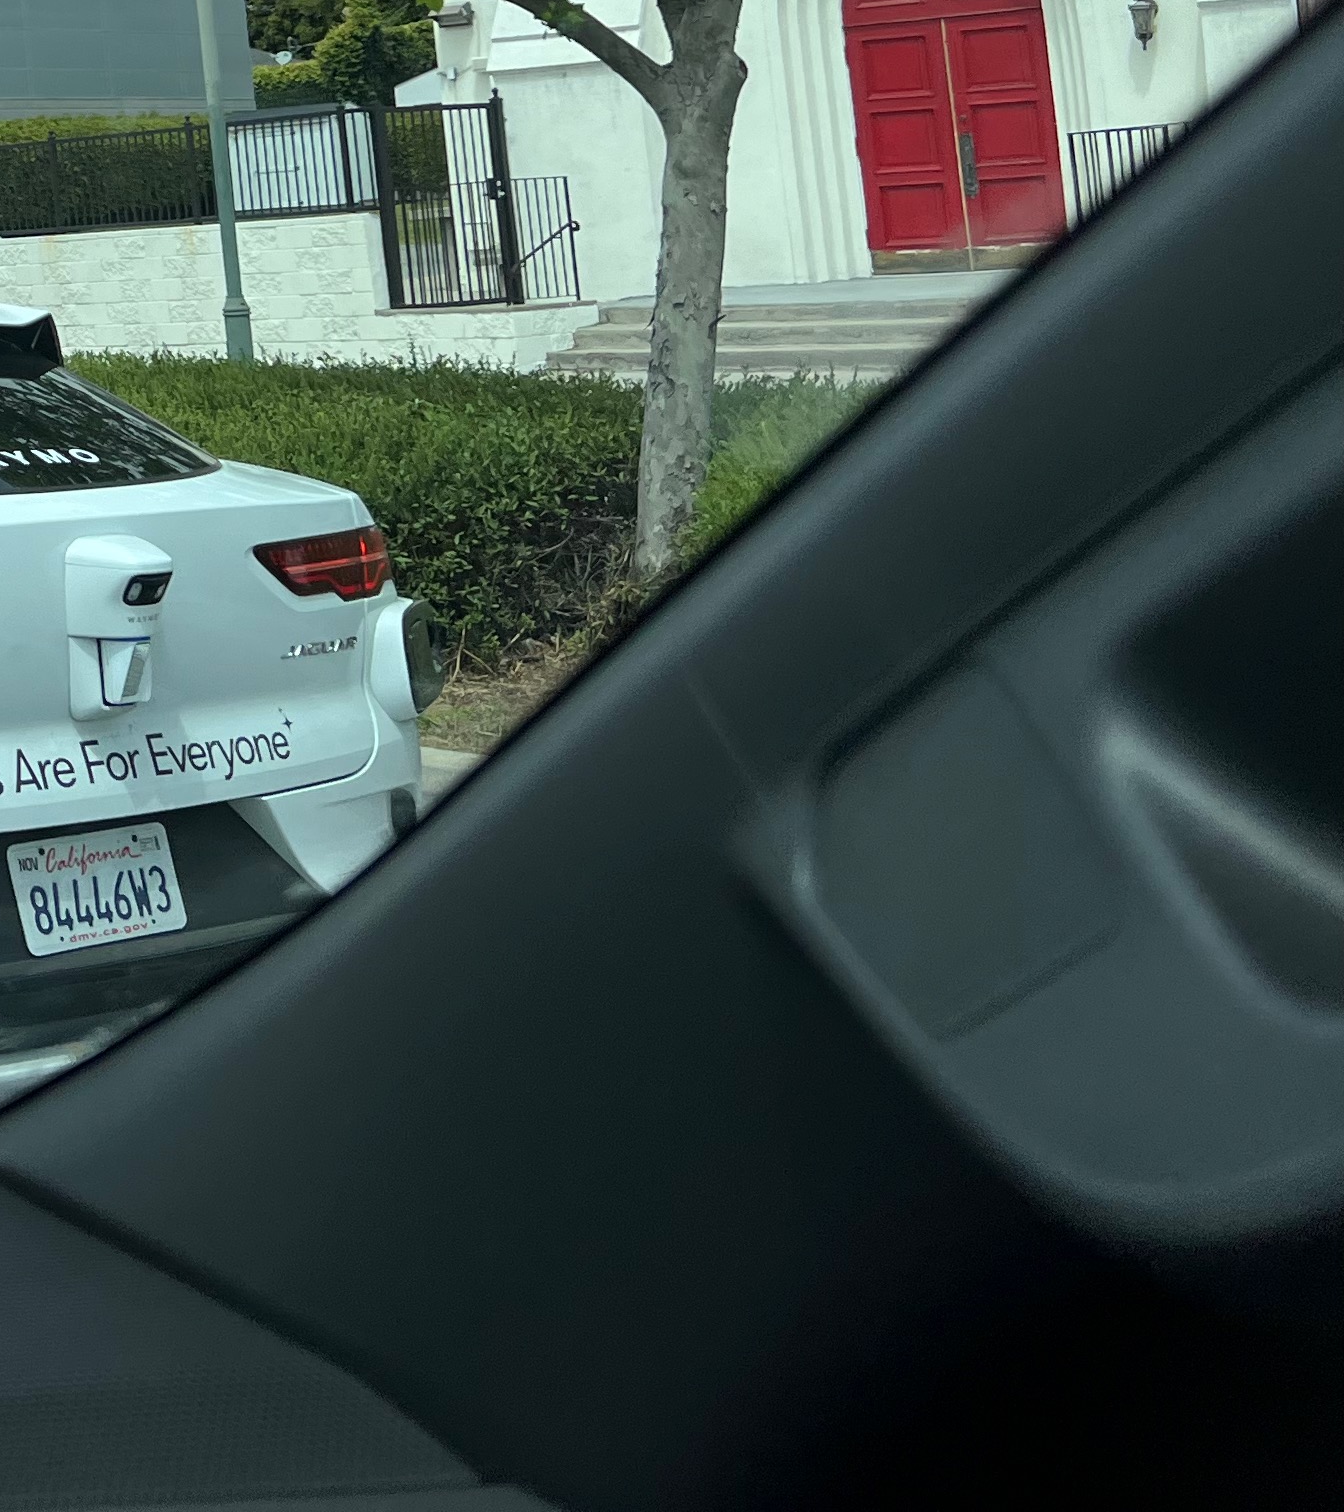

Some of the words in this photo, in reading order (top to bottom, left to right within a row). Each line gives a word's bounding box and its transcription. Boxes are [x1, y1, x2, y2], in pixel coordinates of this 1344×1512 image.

[280, 636, 357, 660] JAGUAR
[14, 748, 77, 794] Are
[79, 739, 141, 784] For
[145, 729, 292, 780] Everyone
[17, 856, 39, 872] NOV
[45, 843, 142, 876] California
[29, 865, 172, 936] 84446W3
[69, 921, 149, 944] dmv.ca.gov
